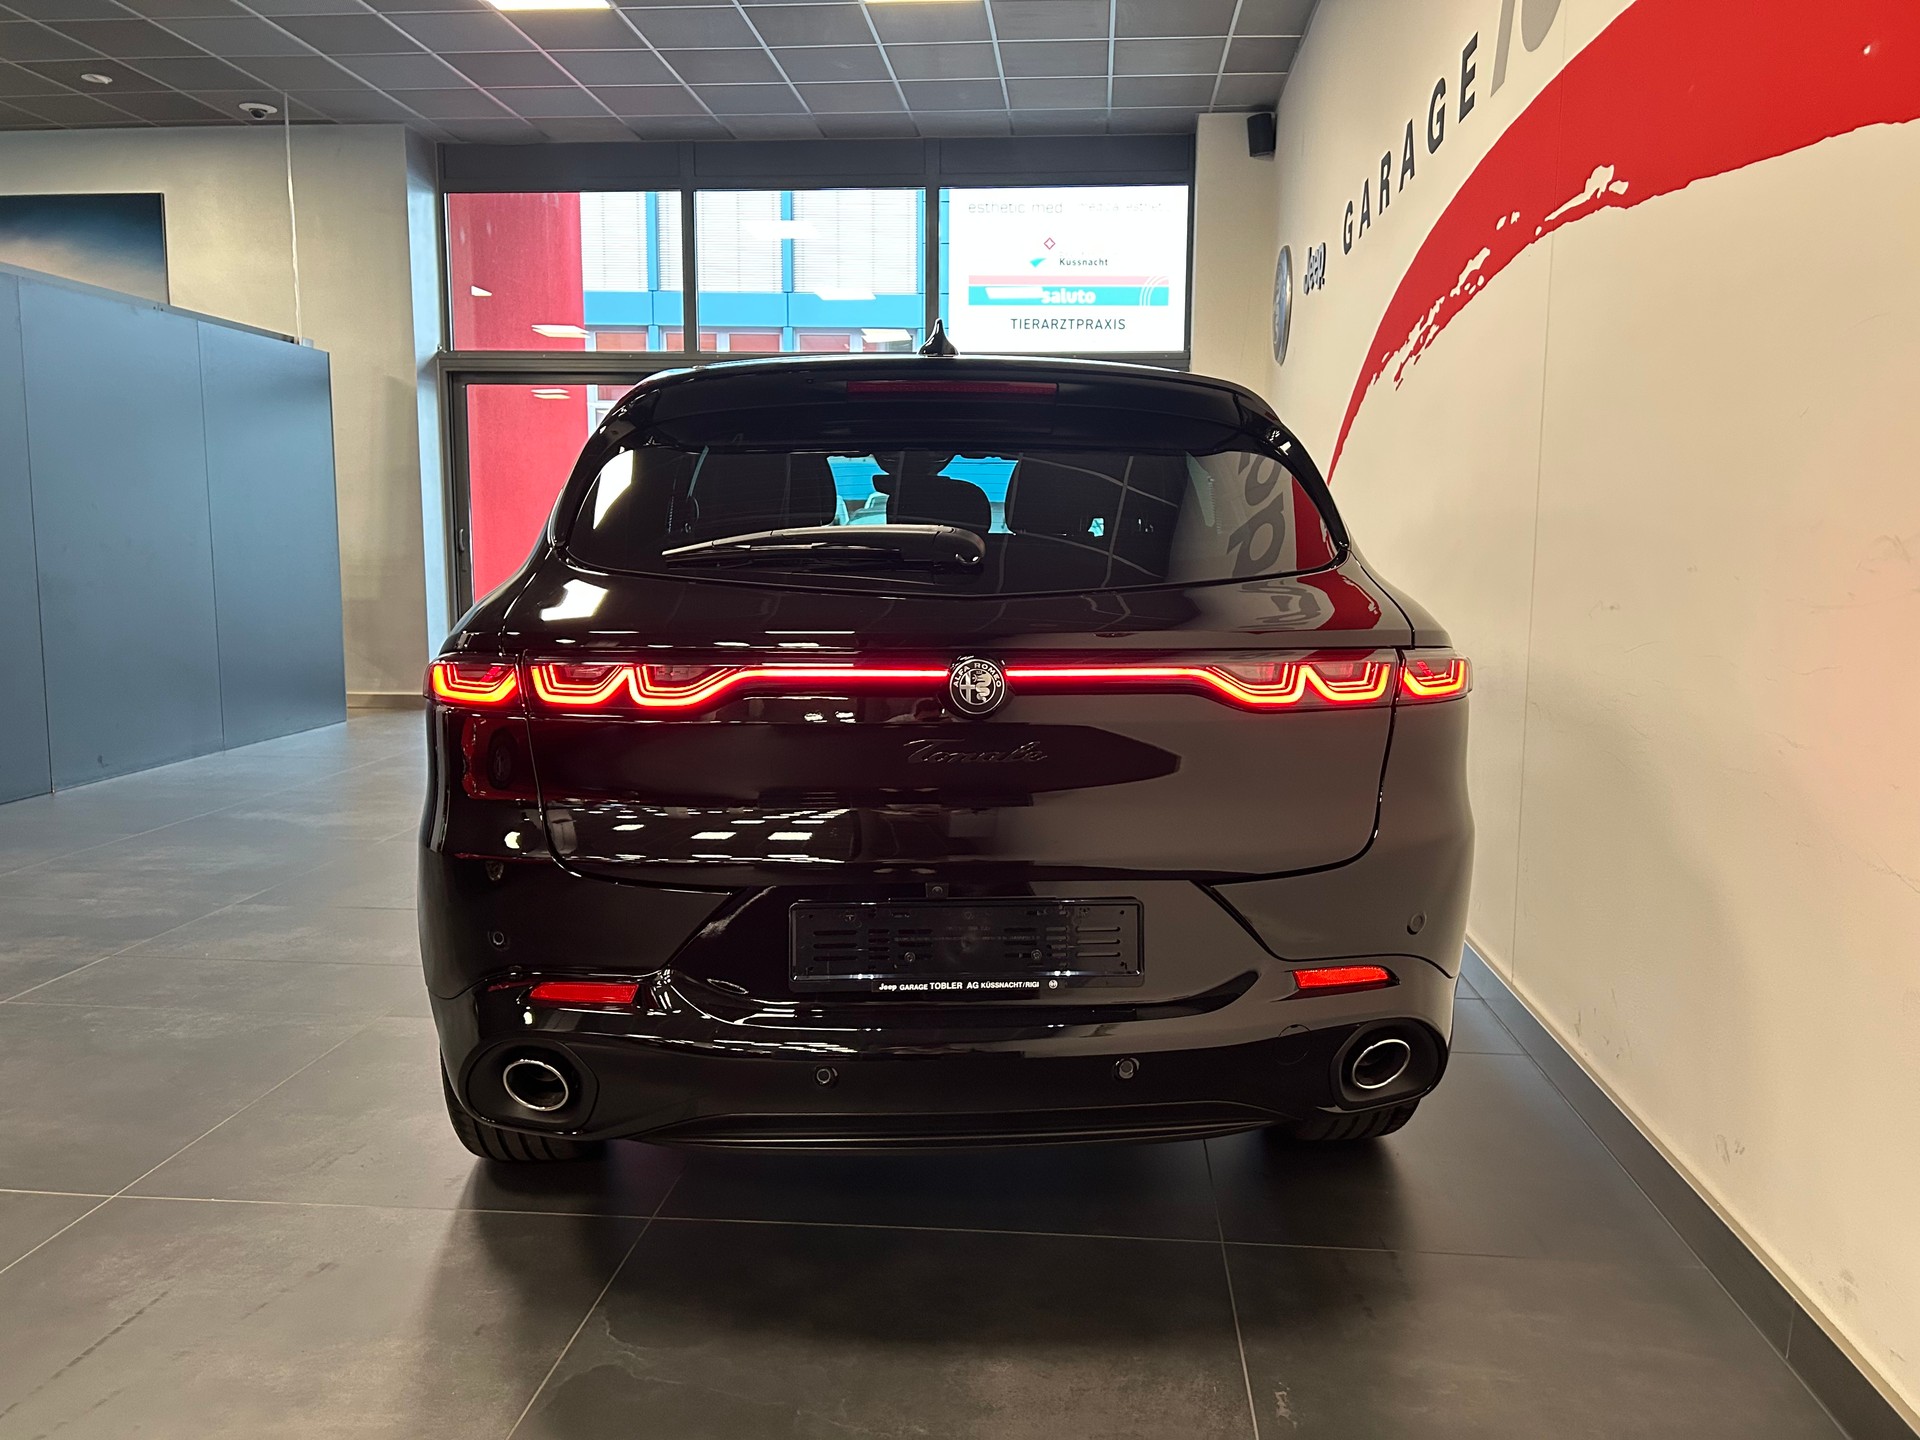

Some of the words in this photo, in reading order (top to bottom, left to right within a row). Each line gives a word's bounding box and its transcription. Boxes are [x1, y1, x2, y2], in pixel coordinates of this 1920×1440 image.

[1343, 31, 1479, 256] GARAGE
[968, 201, 1026, 214] esthetic
[1031, 201, 1064, 214] med
[1303, 241, 1326, 296] Jeep
[1040, 287, 1097, 304] saluto
[1010, 317, 1126, 330] TIERARZTPRAXIS
[953, 665, 971, 688] ALFA
[974, 662, 1002, 688] ROMEO
[878, 983, 898, 992] Jeep
[899, 983, 929, 991] GARAGE
[929, 981, 963, 990] TOBLER
[966, 981, 979, 990] AG
